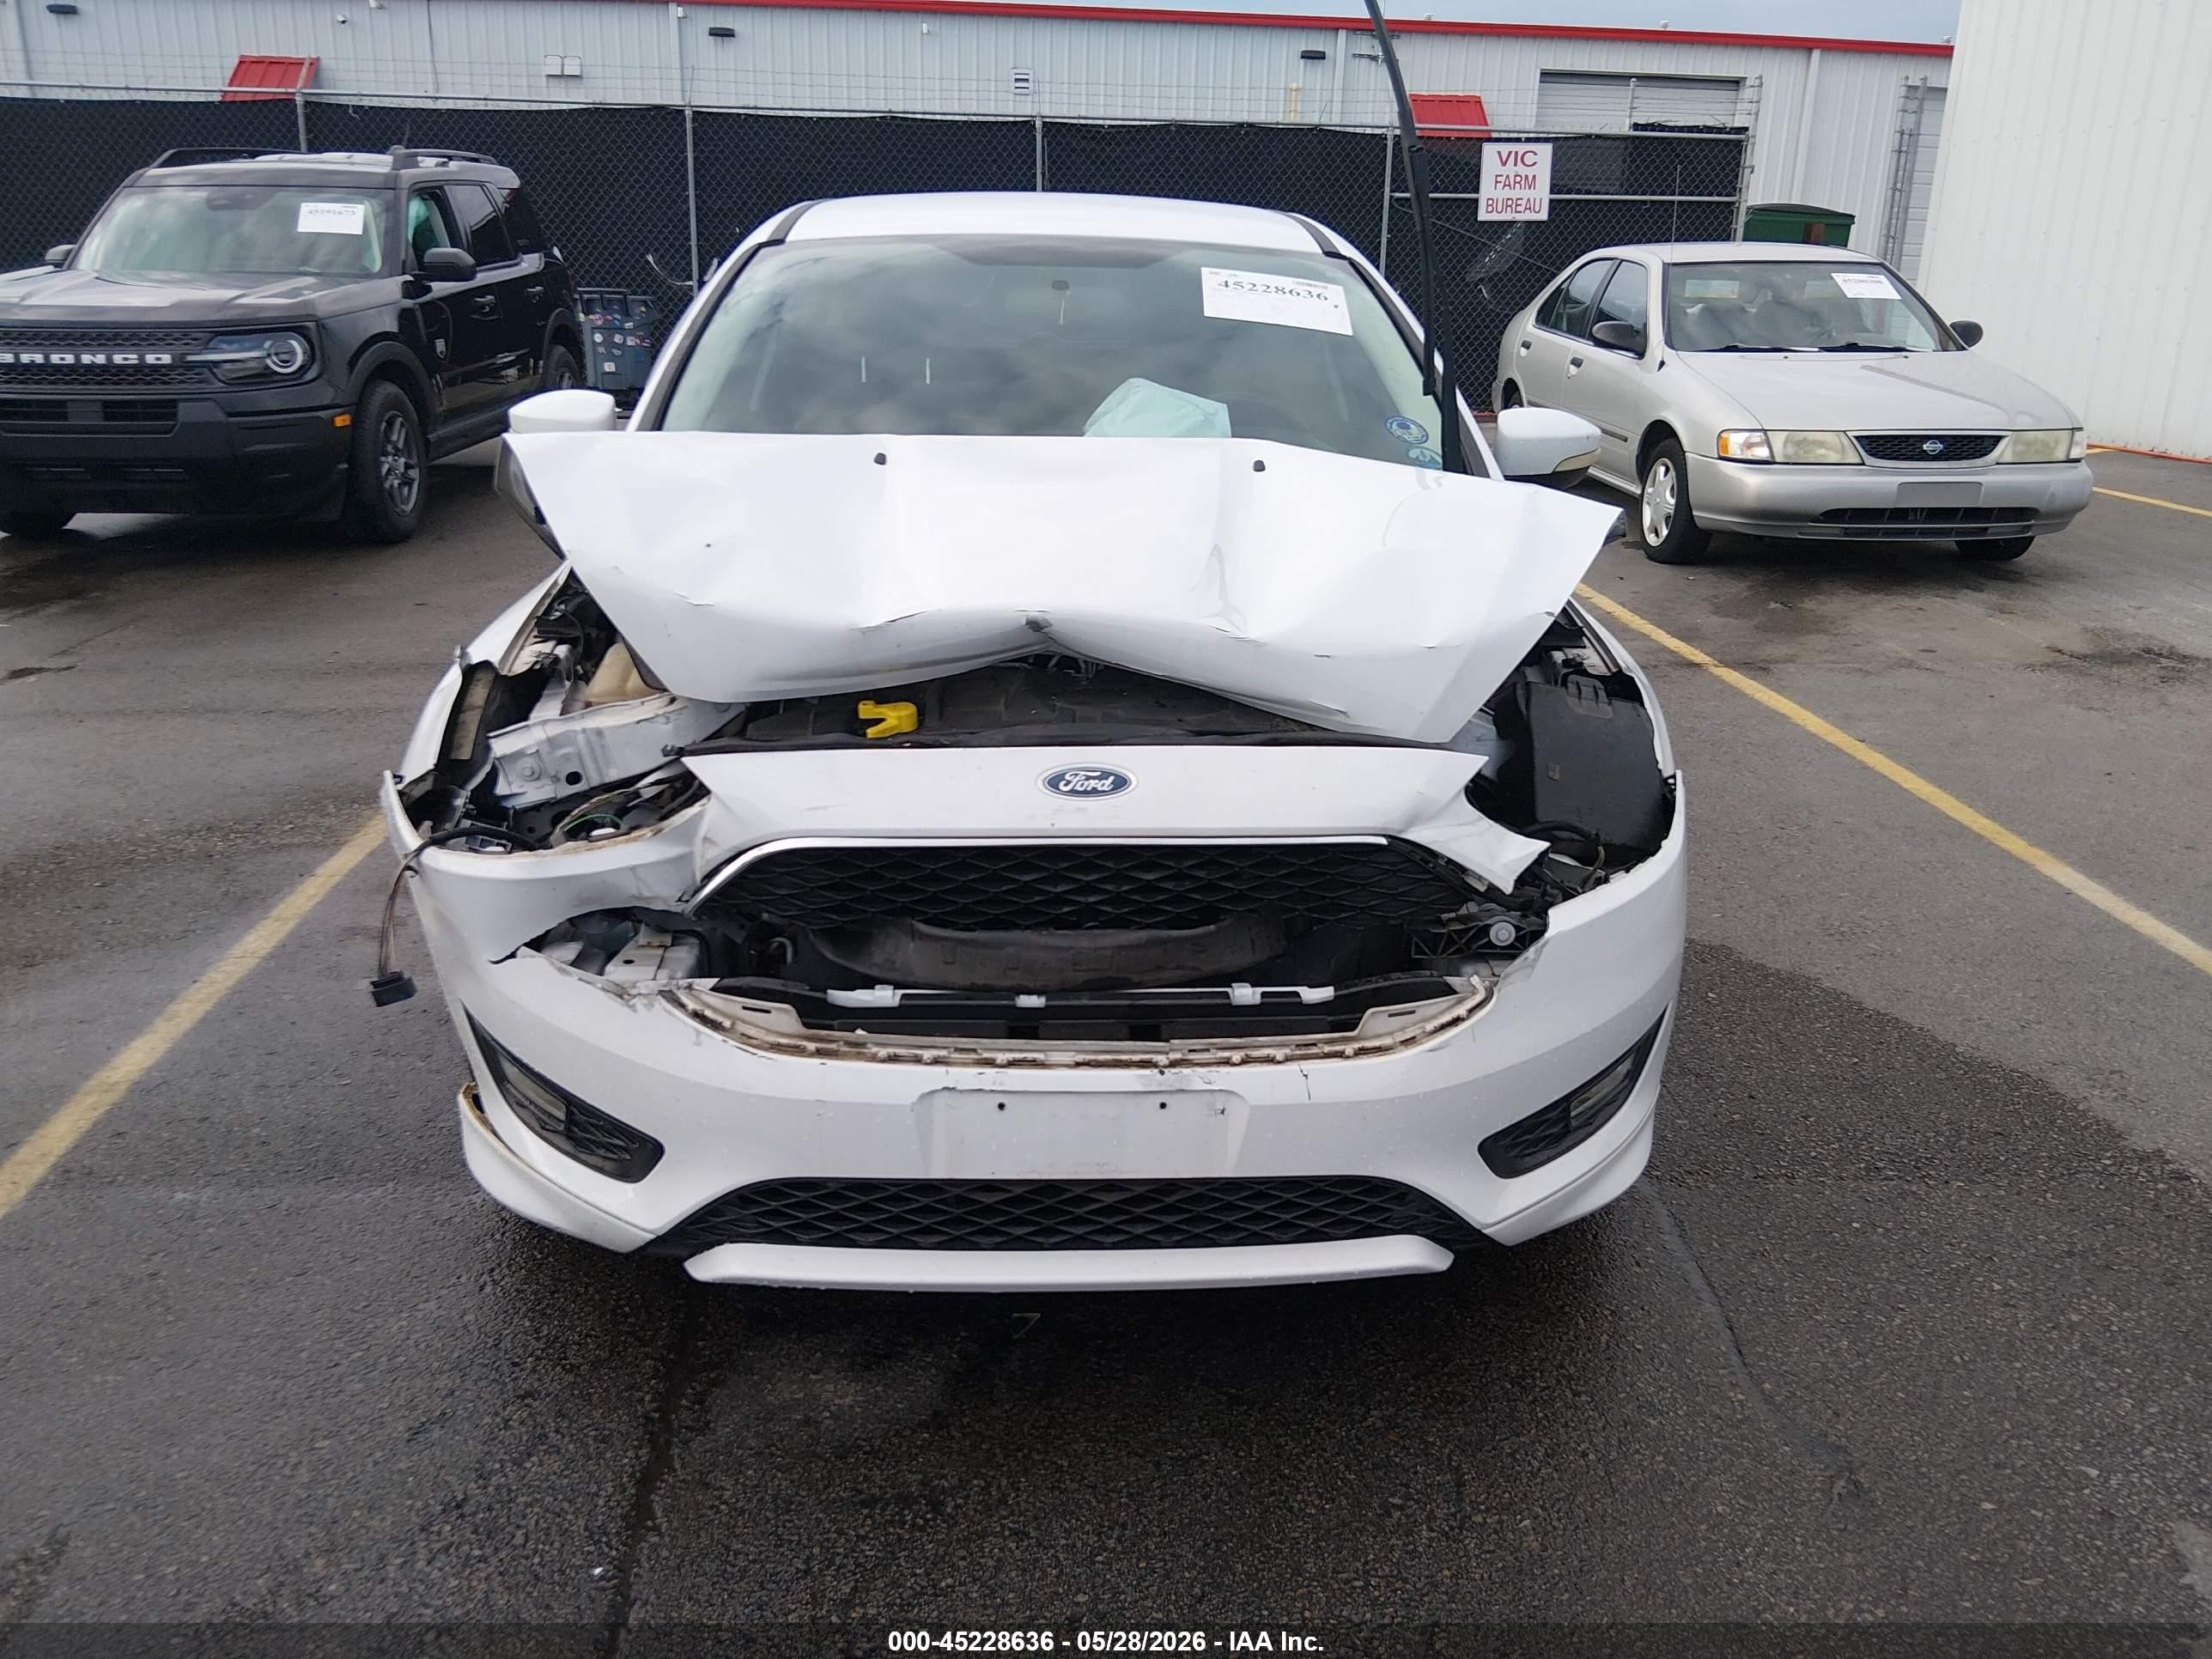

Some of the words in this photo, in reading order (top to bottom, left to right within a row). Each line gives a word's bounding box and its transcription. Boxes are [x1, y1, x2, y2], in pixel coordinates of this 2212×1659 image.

[1497, 150, 1539, 167] VIC
[1494, 174, 1537, 191] FARM
[1486, 198, 1543, 214] BUREAU
[1218, 280, 1328, 301] 45228636
[1059, 771, 1115, 792] Ford
